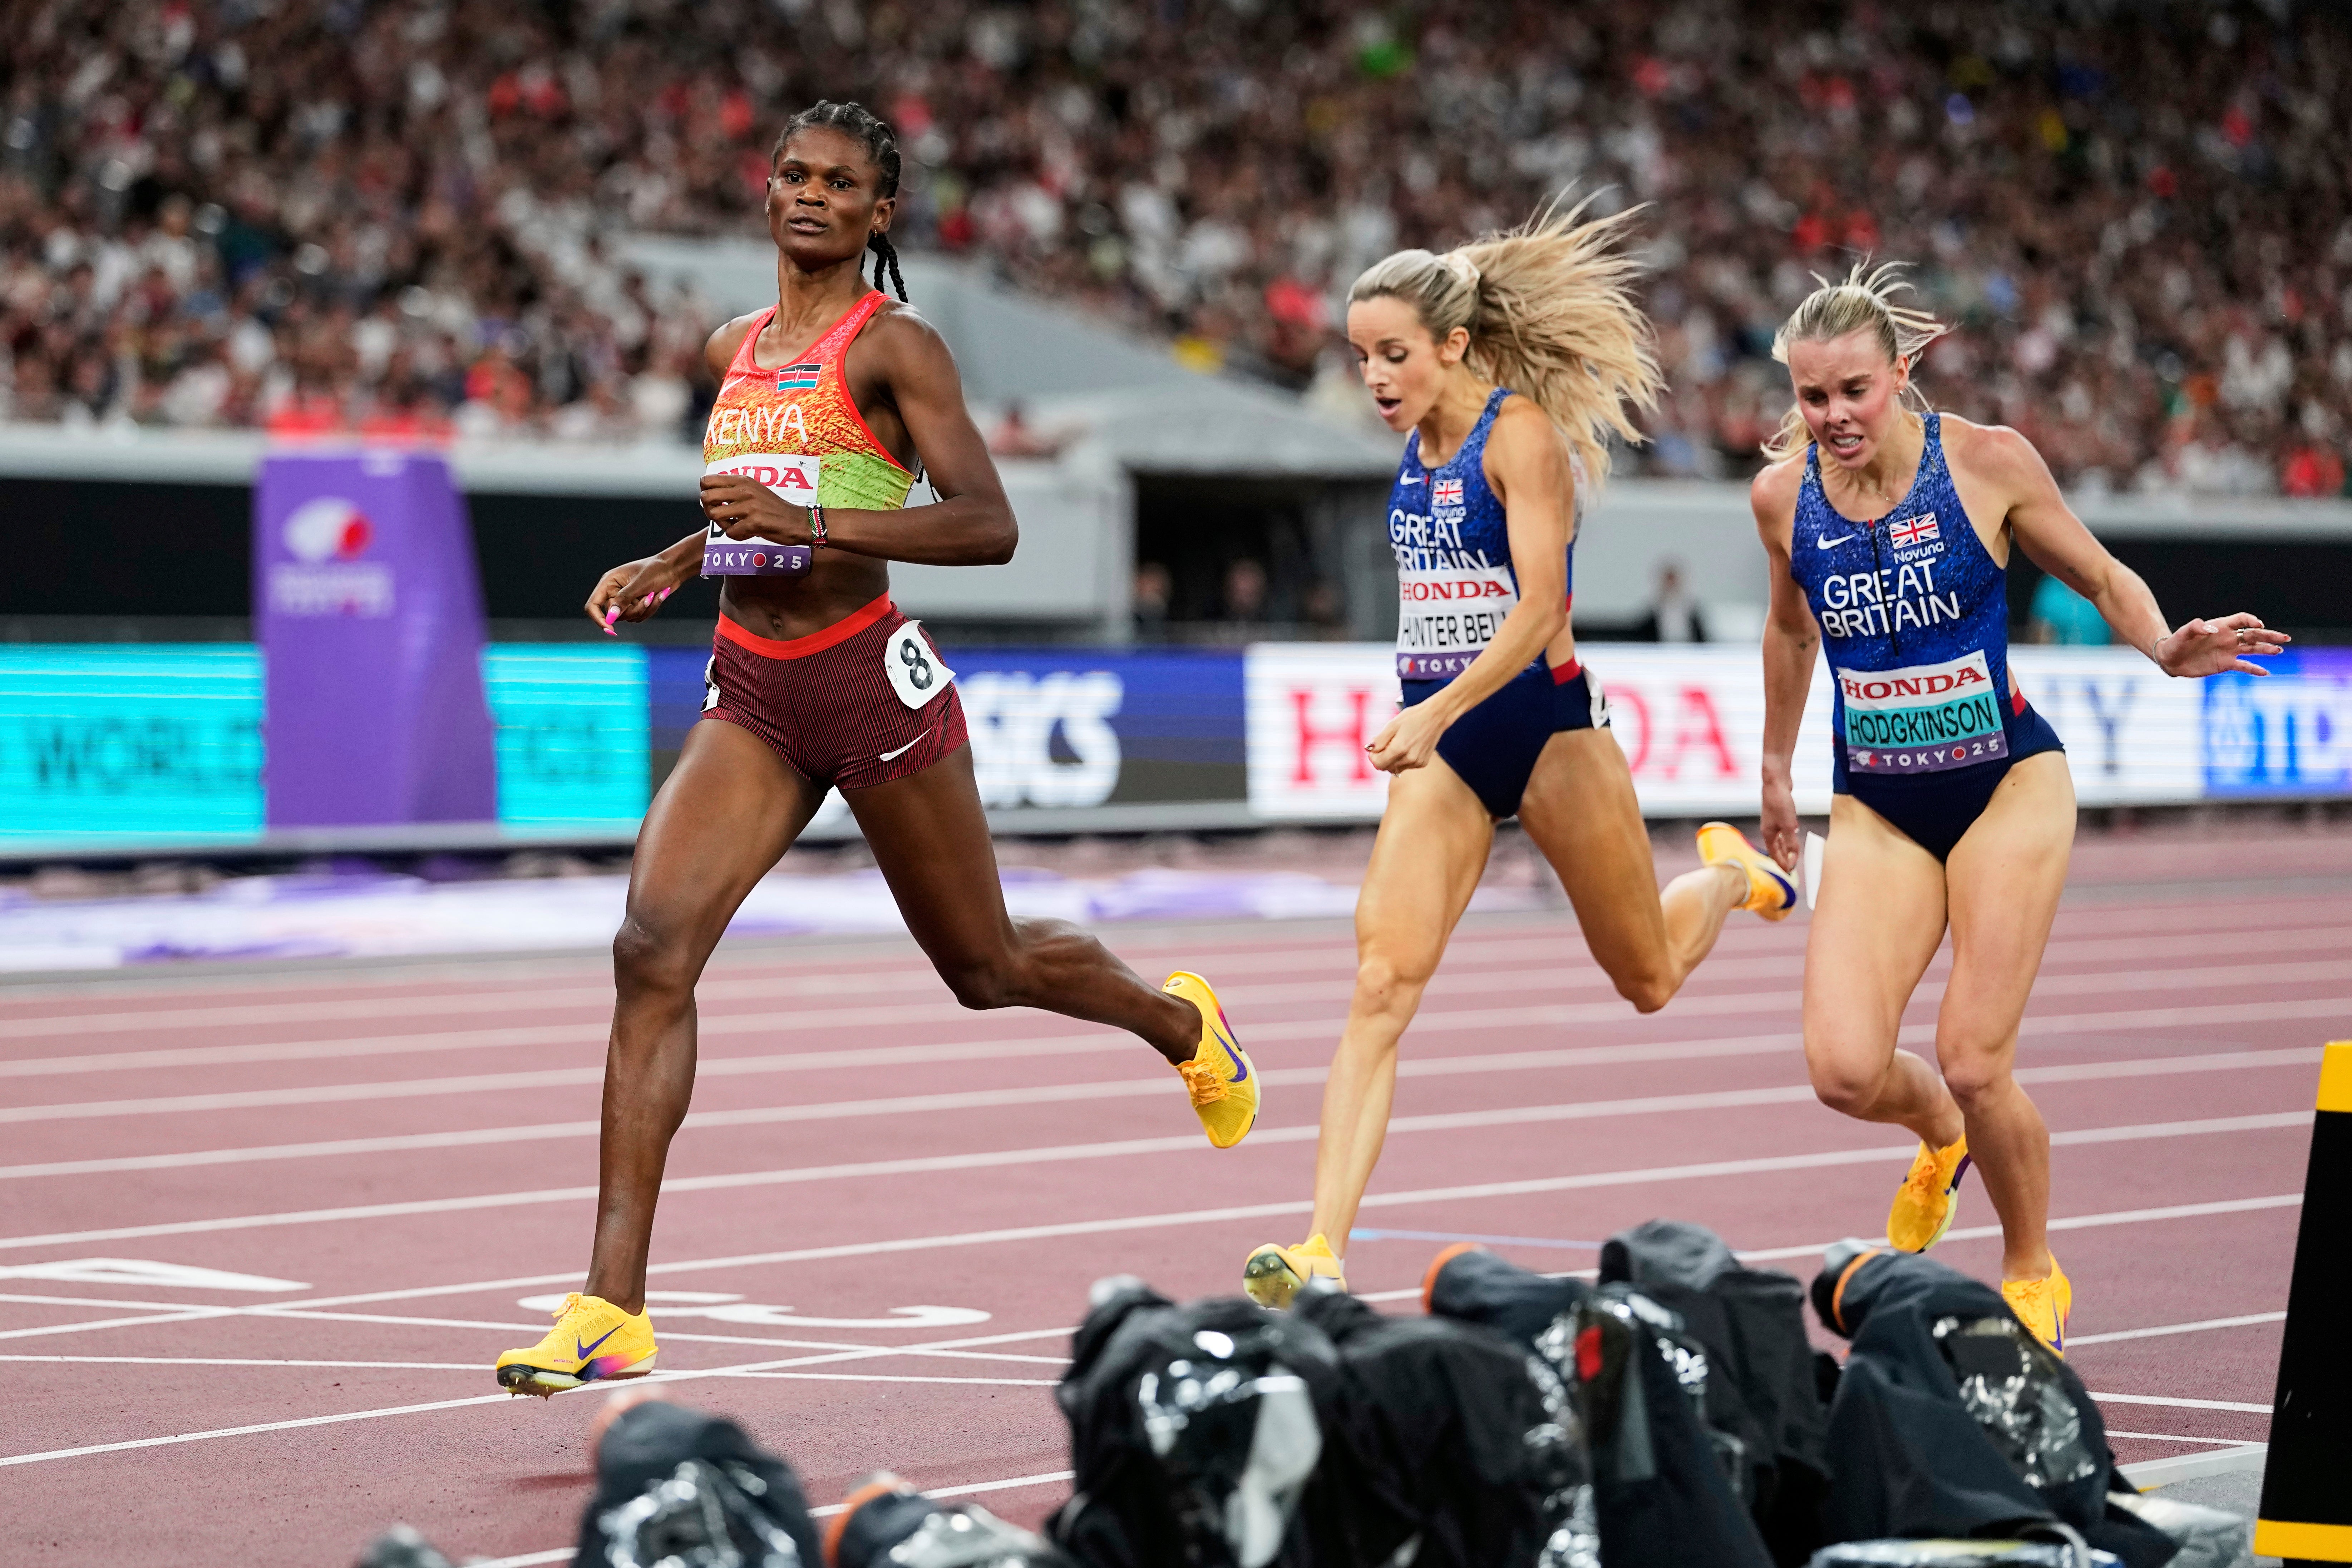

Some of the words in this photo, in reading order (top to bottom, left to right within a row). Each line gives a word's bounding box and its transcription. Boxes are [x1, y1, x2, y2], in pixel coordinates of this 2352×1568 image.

[704, 404, 808, 445] KENYA
[1390, 508, 1463, 548] GREAT
[773, 554, 802, 569] 25
[1894, 542, 1945, 564] Novuna
[1401, 580, 1511, 601] HONDA
[1823, 557, 1937, 610] GREAT
[1401, 616, 1459, 647] HUNTER
[1464, 610, 1506, 644] BEL
[1821, 591, 1961, 638] BRITAIN
[900, 638, 933, 690] 8
[1844, 665, 1987, 700] HONDA
[1849, 697, 1995, 744] HODGKINSON
[1972, 739, 2000, 756] 25
